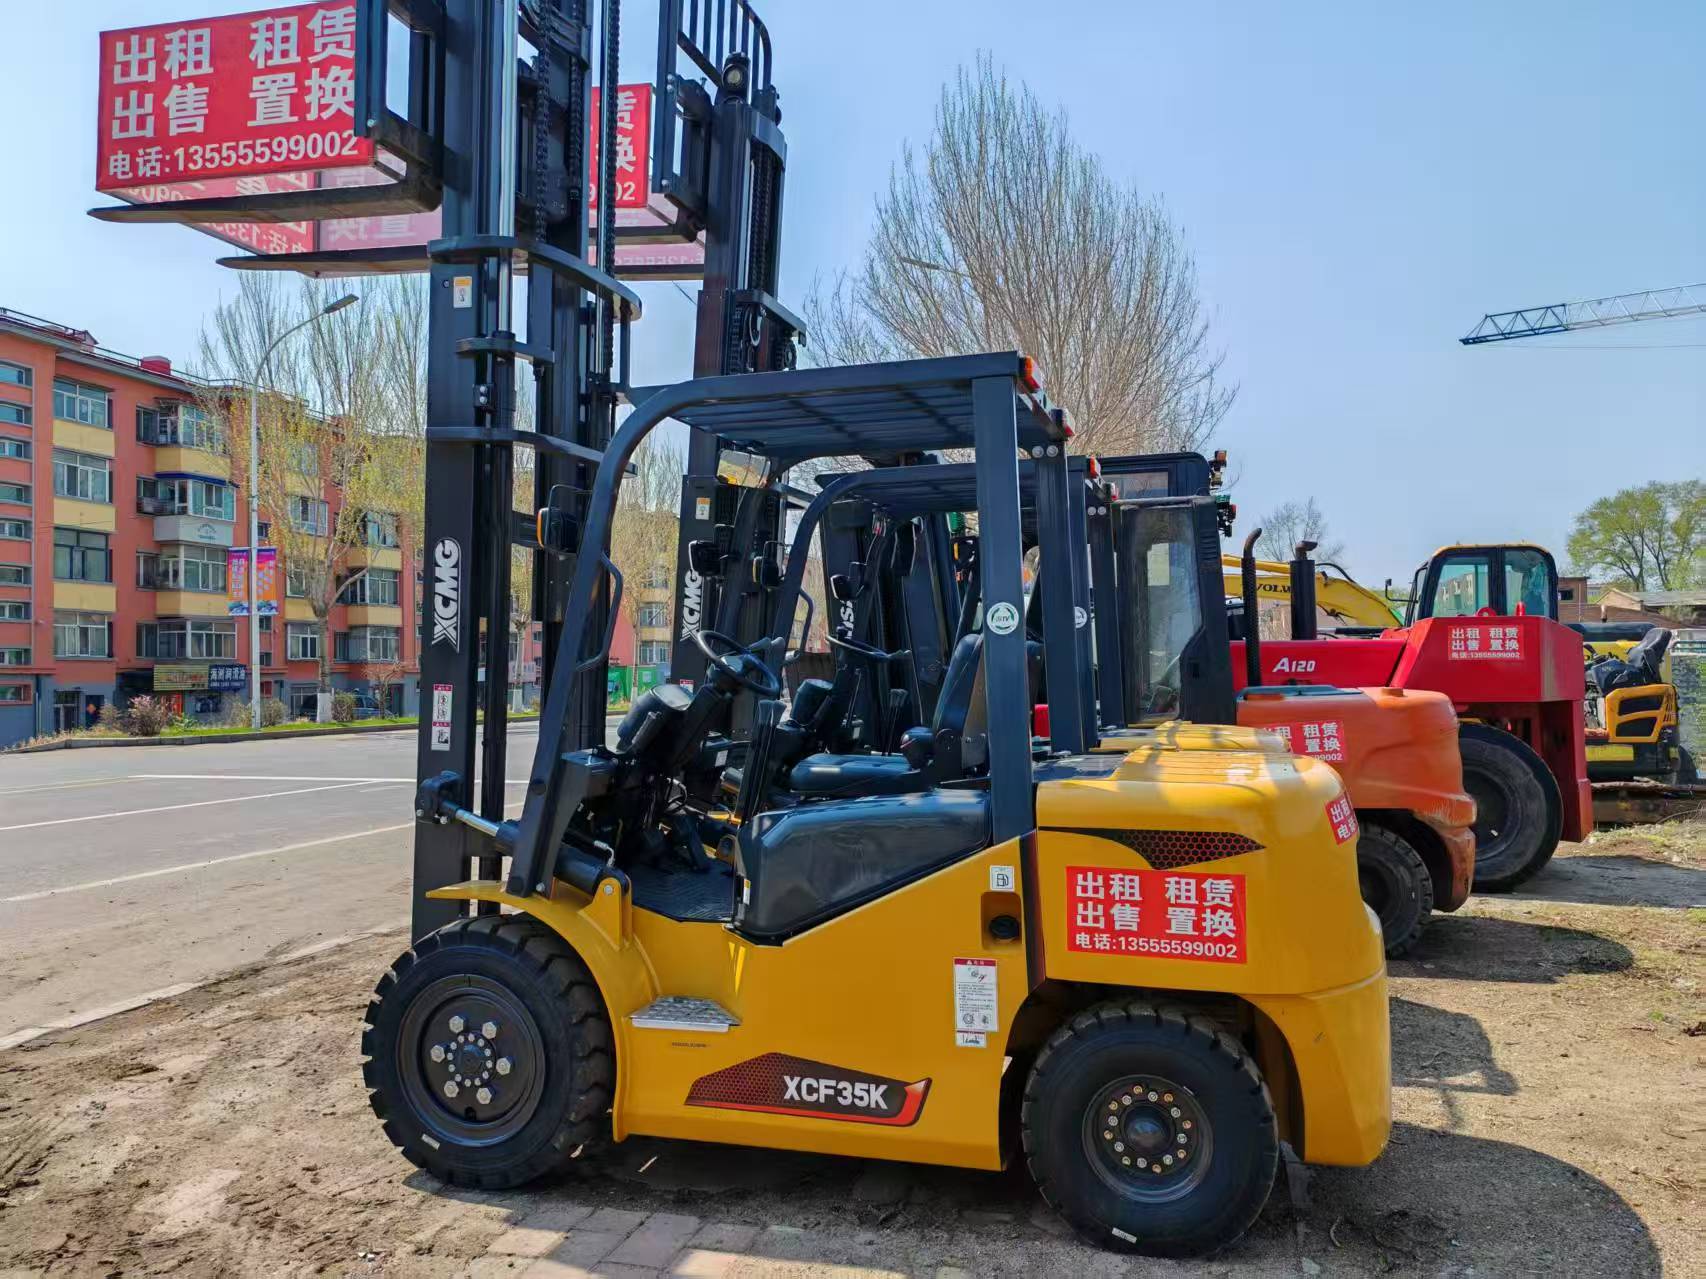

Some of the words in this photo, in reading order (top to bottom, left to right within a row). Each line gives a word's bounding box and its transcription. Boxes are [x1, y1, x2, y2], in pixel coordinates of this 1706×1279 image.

[113, 27, 214, 84] 出租
[249, 5, 357, 69] 租赁
[112, 82, 209, 139] 出售
[247, 65, 355, 127] 置换
[432, 538, 461, 654] XCMG
[680, 569, 704, 642] XCMG
[1451, 639, 1480, 650] 出售
[1490, 639, 1519, 651] 置换
[1452, 627, 1480, 639] 出租
[1272, 657, 1316, 673] A120
[1303, 722, 1337, 738] 租赁
[1305, 737, 1340, 753] 置换
[1076, 872, 1142, 901] 出租
[1165, 877, 1234, 907] 租赁
[1076, 901, 1141, 931] 出售
[1166, 907, 1236, 938] 置换
[1075, 932, 1237, 958] 电话:13555599002
[783, 1075, 888, 1110] XCF35K
